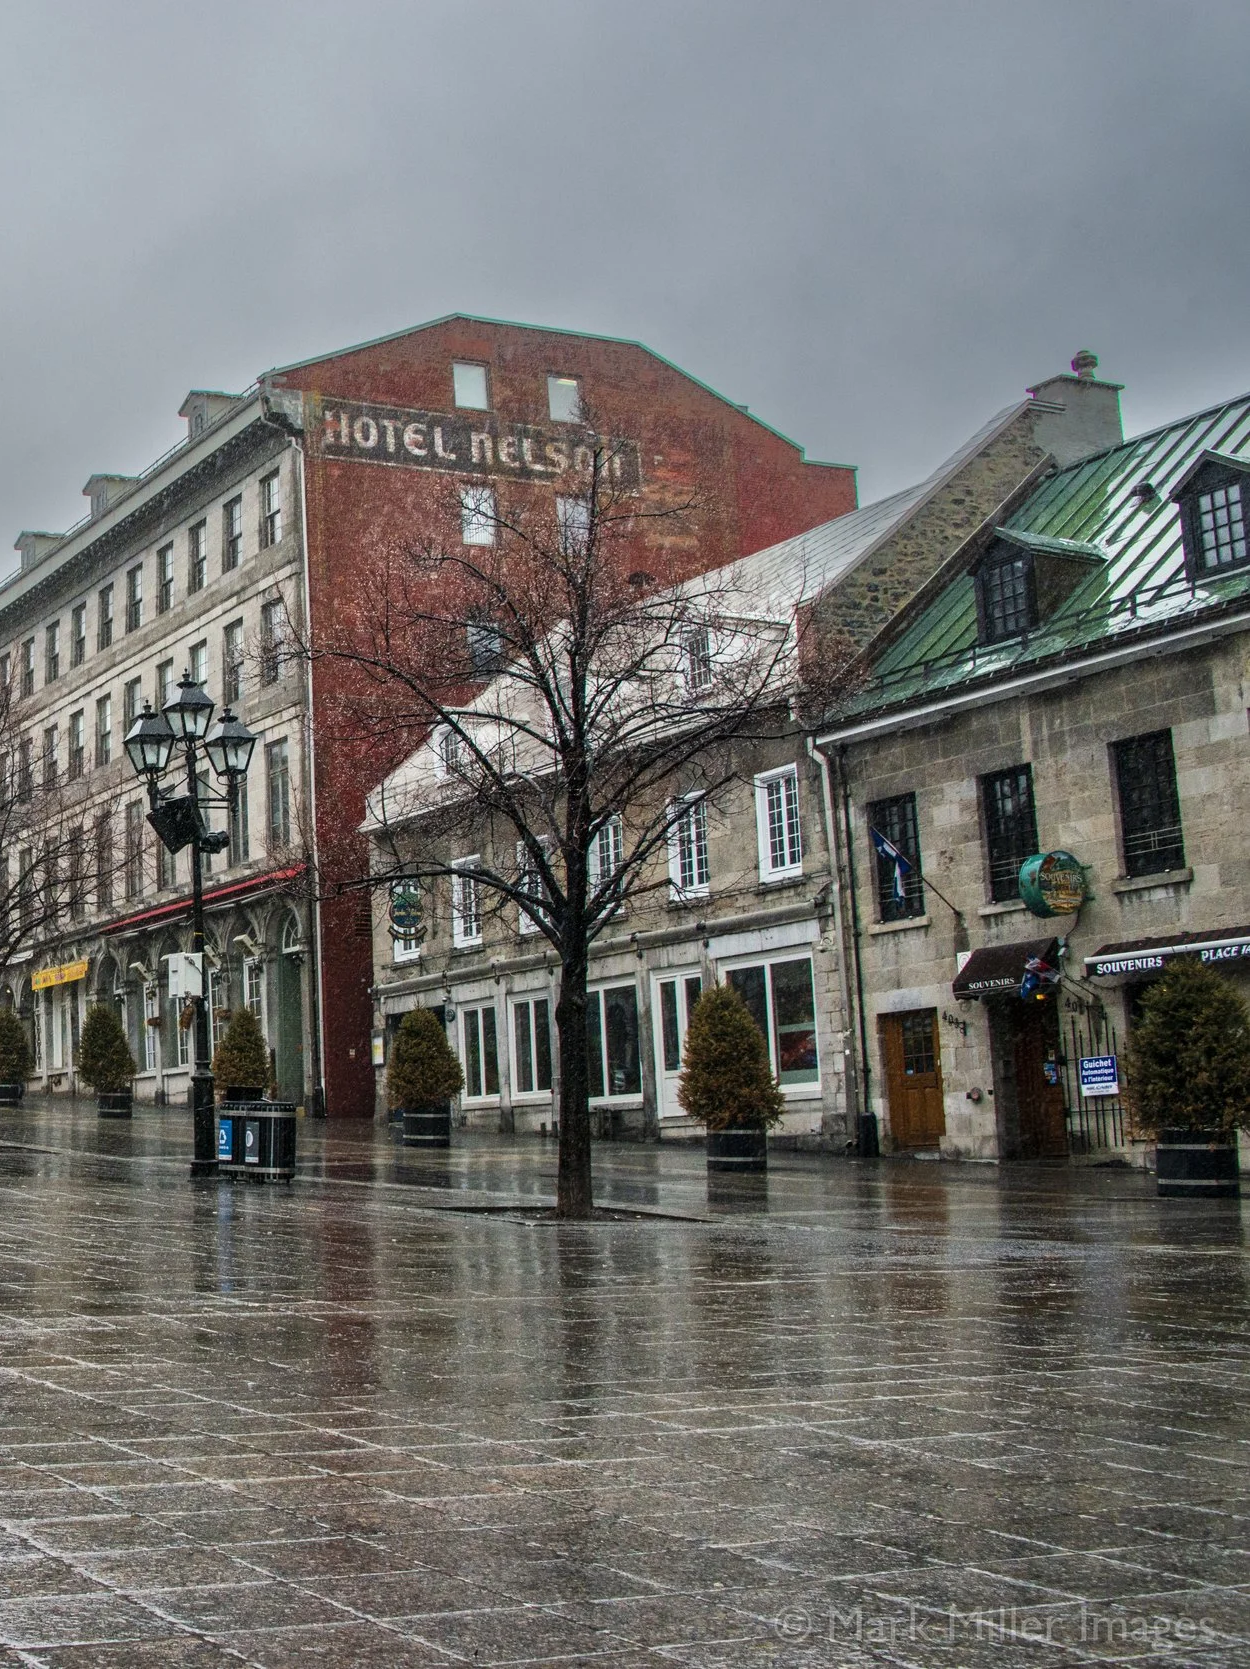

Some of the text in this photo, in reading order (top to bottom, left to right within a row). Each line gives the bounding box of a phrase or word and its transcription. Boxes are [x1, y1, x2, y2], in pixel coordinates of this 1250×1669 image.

[323, 409, 456, 461] HOTEL
[1096, 956, 1163, 975] SOUVENIRS
[1201, 946, 1239, 961] PLACE
[968, 977, 1015, 990] SOUVENIRS
[1083, 1059, 1111, 1068] Guichet
